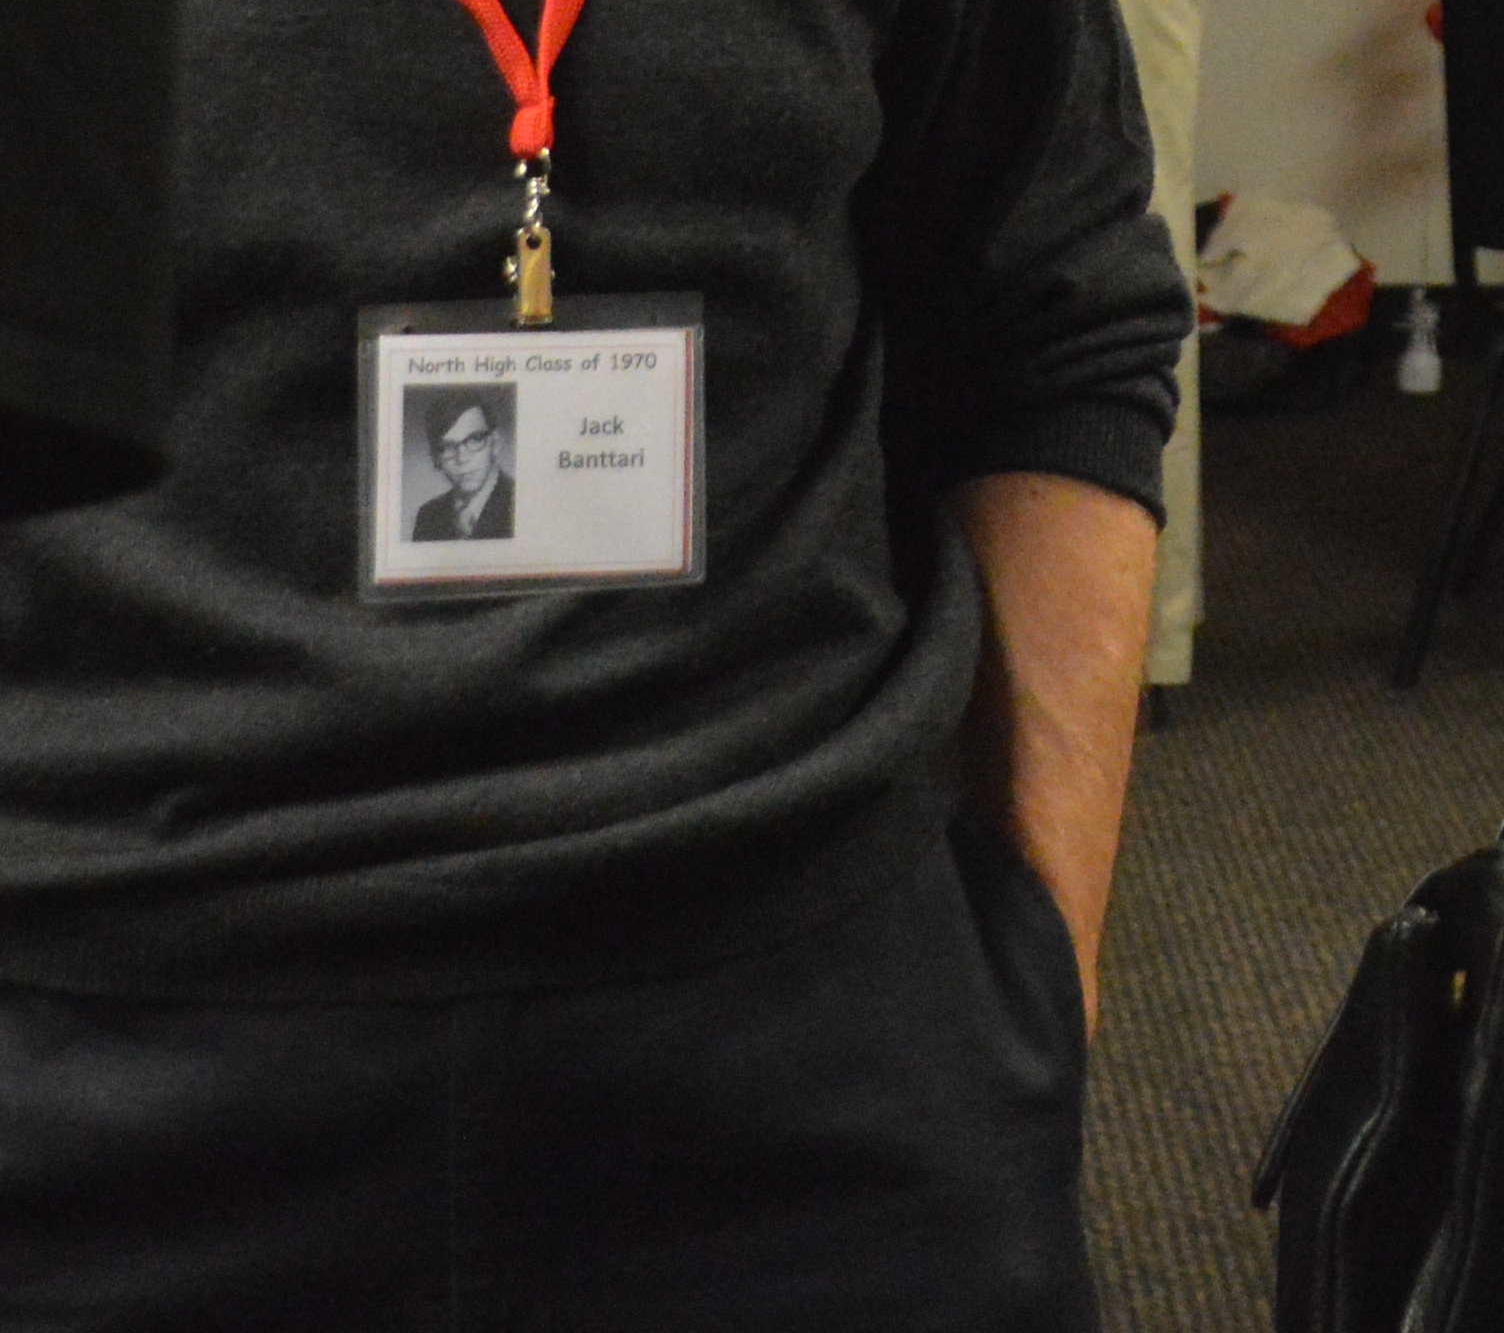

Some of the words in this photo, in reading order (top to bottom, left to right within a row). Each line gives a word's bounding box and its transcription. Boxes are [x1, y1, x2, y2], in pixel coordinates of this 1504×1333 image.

[408, 357, 465, 374] North
[474, 354, 516, 378] High
[525, 354, 572, 372] Class
[581, 353, 601, 371] of
[610, 351, 658, 370] 1970
[579, 415, 624, 436] Jack
[558, 447, 646, 470] Banttari
